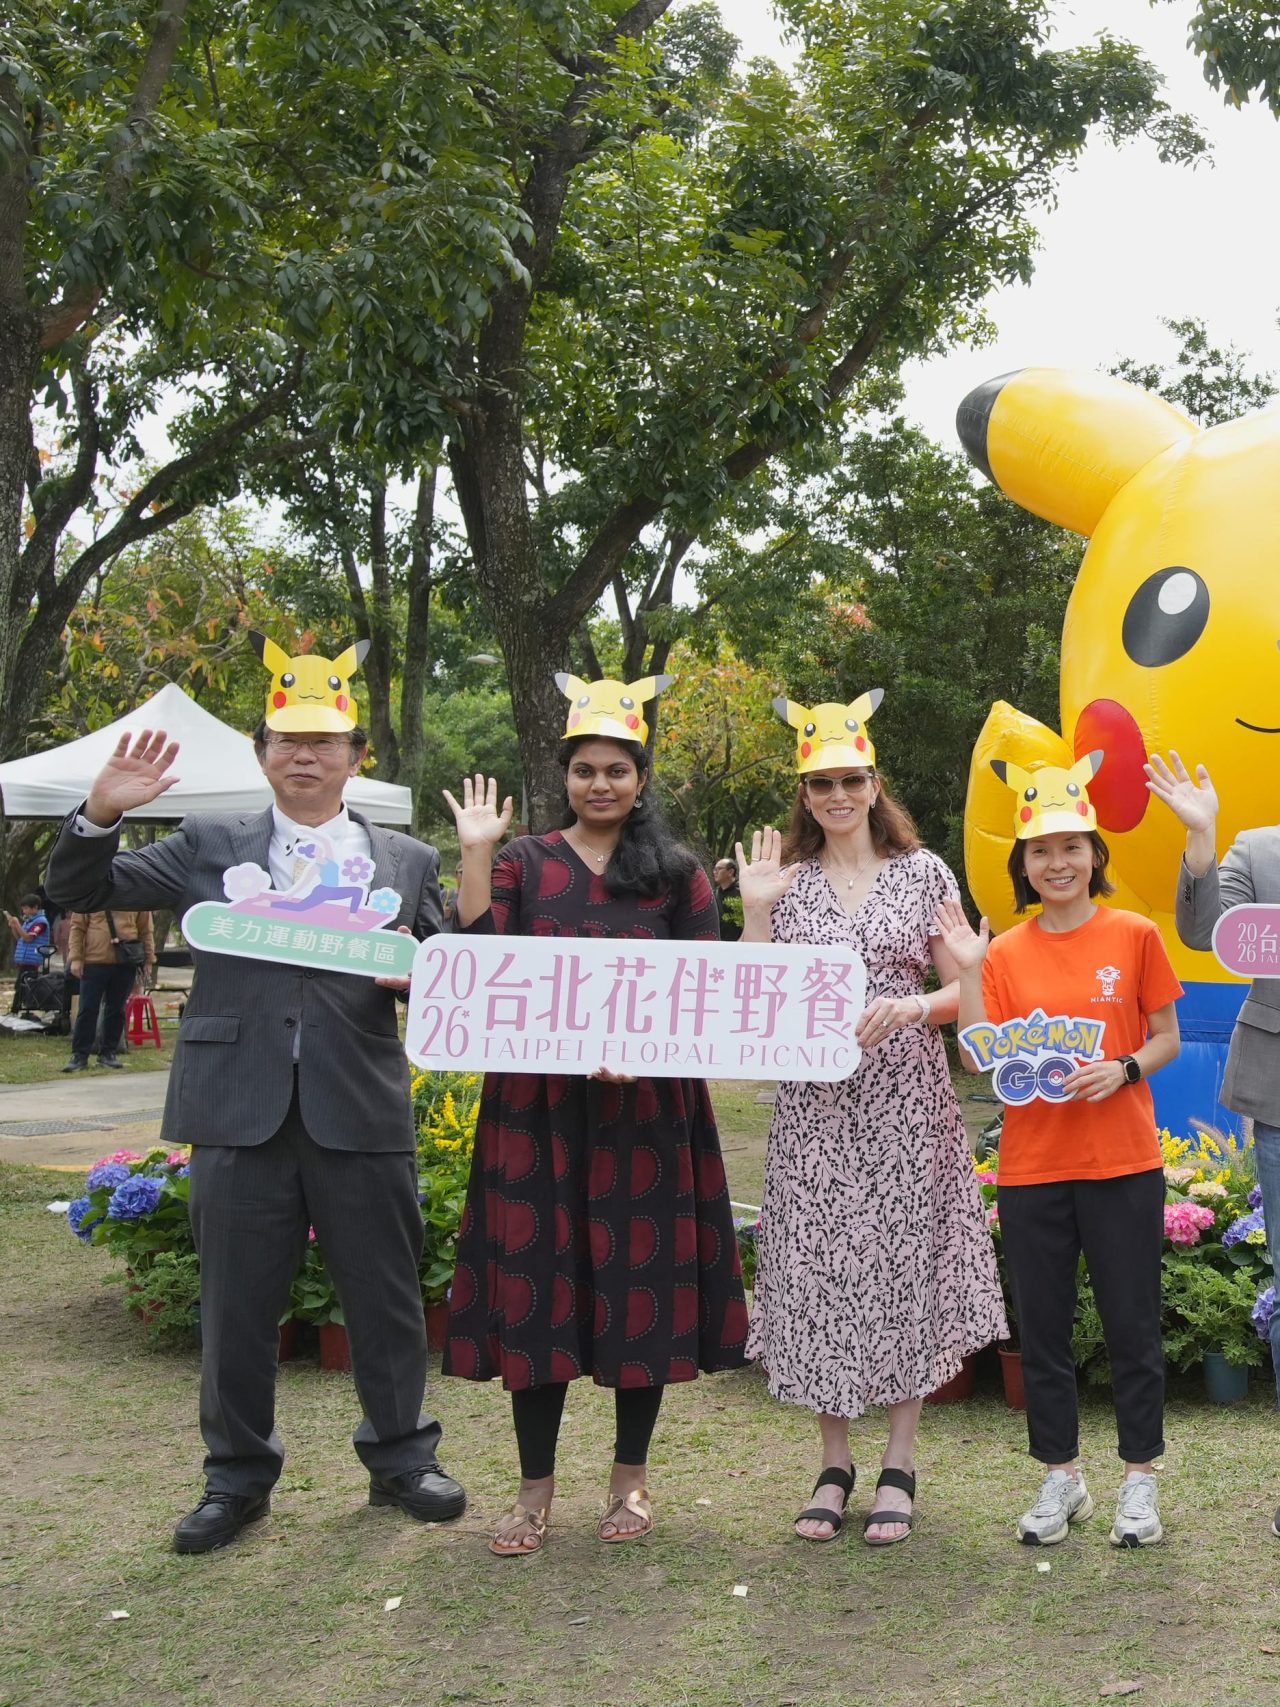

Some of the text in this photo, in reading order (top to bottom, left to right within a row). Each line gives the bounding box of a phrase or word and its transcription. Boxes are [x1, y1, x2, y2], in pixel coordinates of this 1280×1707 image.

[208, 915, 397, 965] 美力運動野餐區
[423, 948, 477, 1000] 20
[484, 952, 853, 1040] 台北花伴野餐
[419, 1005, 470, 1058] 26
[480, 1036, 850, 1069] TAIPEI FLORAL PICNIC
[998, 1057, 1077, 1101] GO
